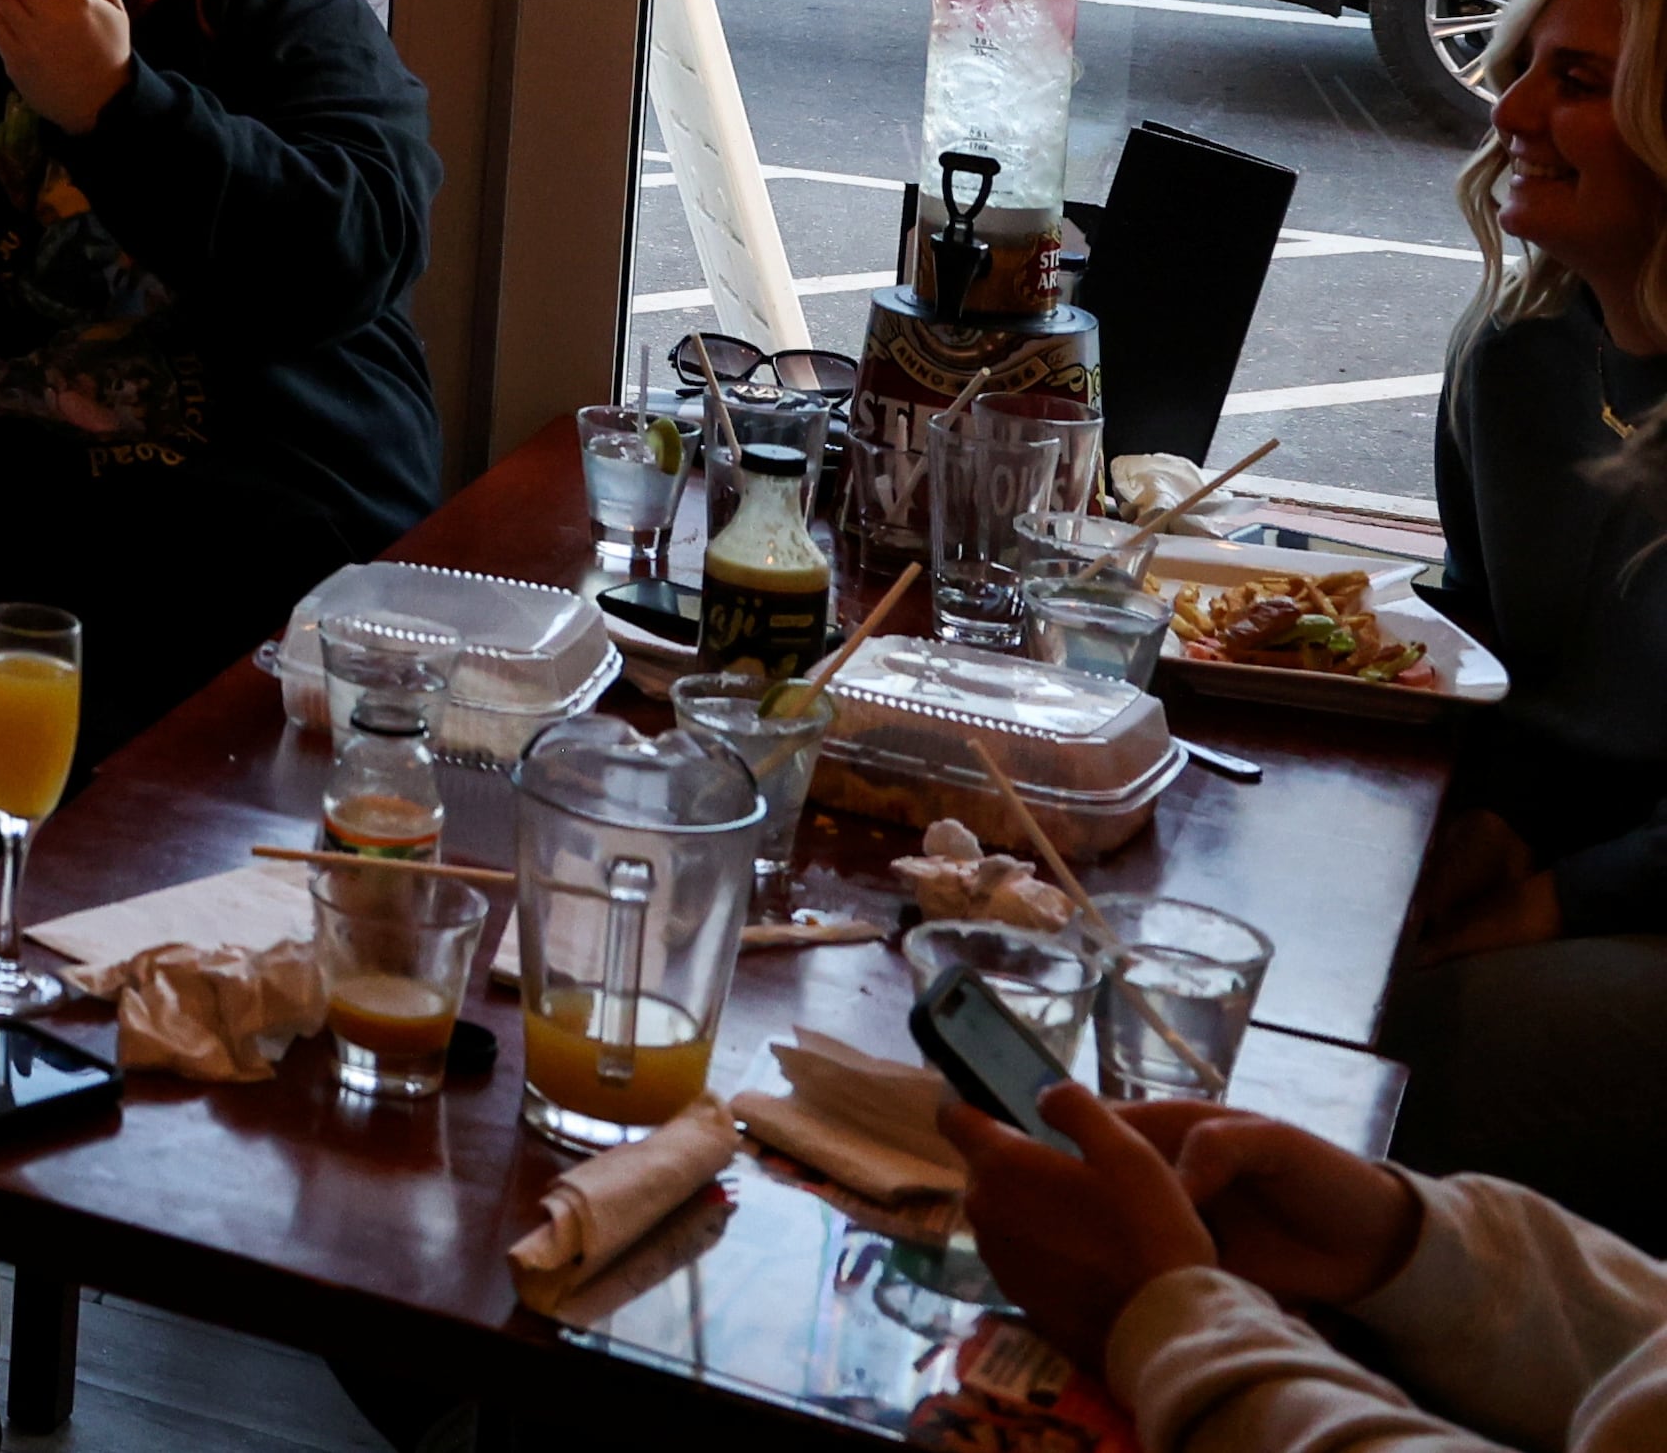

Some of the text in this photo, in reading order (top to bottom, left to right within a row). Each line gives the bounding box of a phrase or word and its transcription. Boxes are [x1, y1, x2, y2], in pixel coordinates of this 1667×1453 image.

[895, 346, 945, 387] ANNO
[169, 351, 212, 444] Brick
[88, 442, 188, 479] Road
